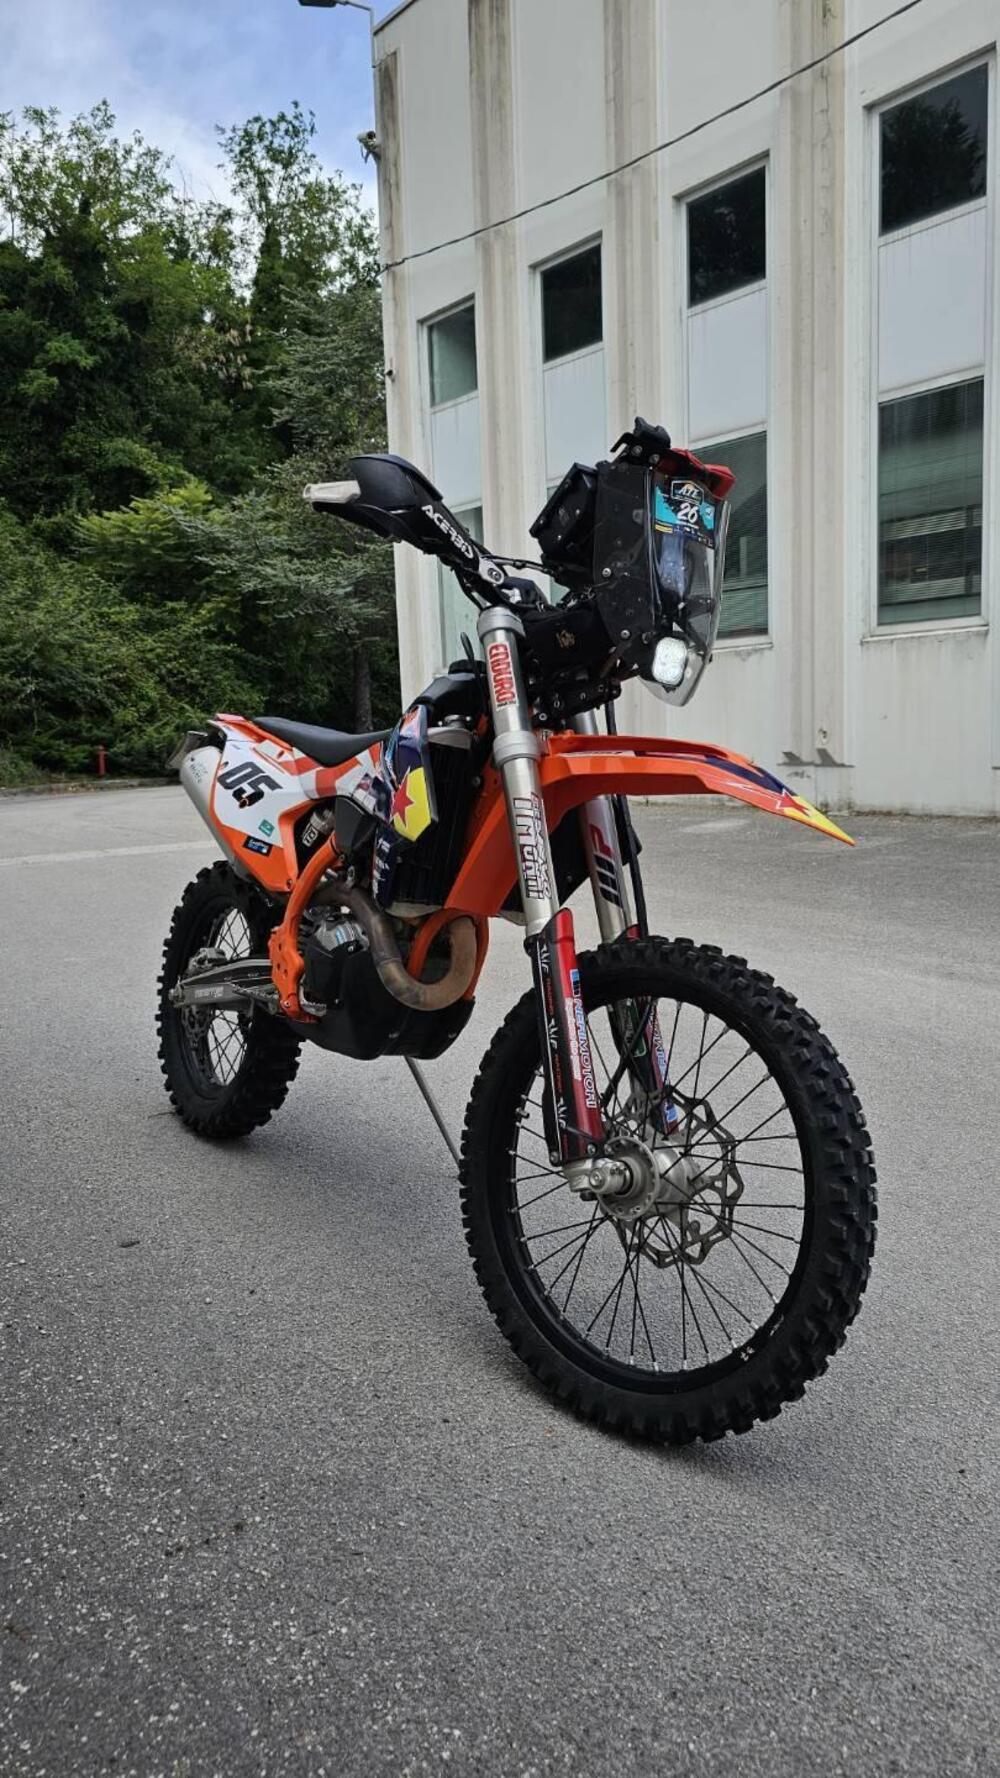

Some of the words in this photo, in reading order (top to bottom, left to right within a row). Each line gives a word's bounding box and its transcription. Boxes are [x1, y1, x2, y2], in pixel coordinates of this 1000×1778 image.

[677, 502, 699, 523] 26
[489, 644, 516, 703] ENDURO
[217, 761, 283, 809] 05
